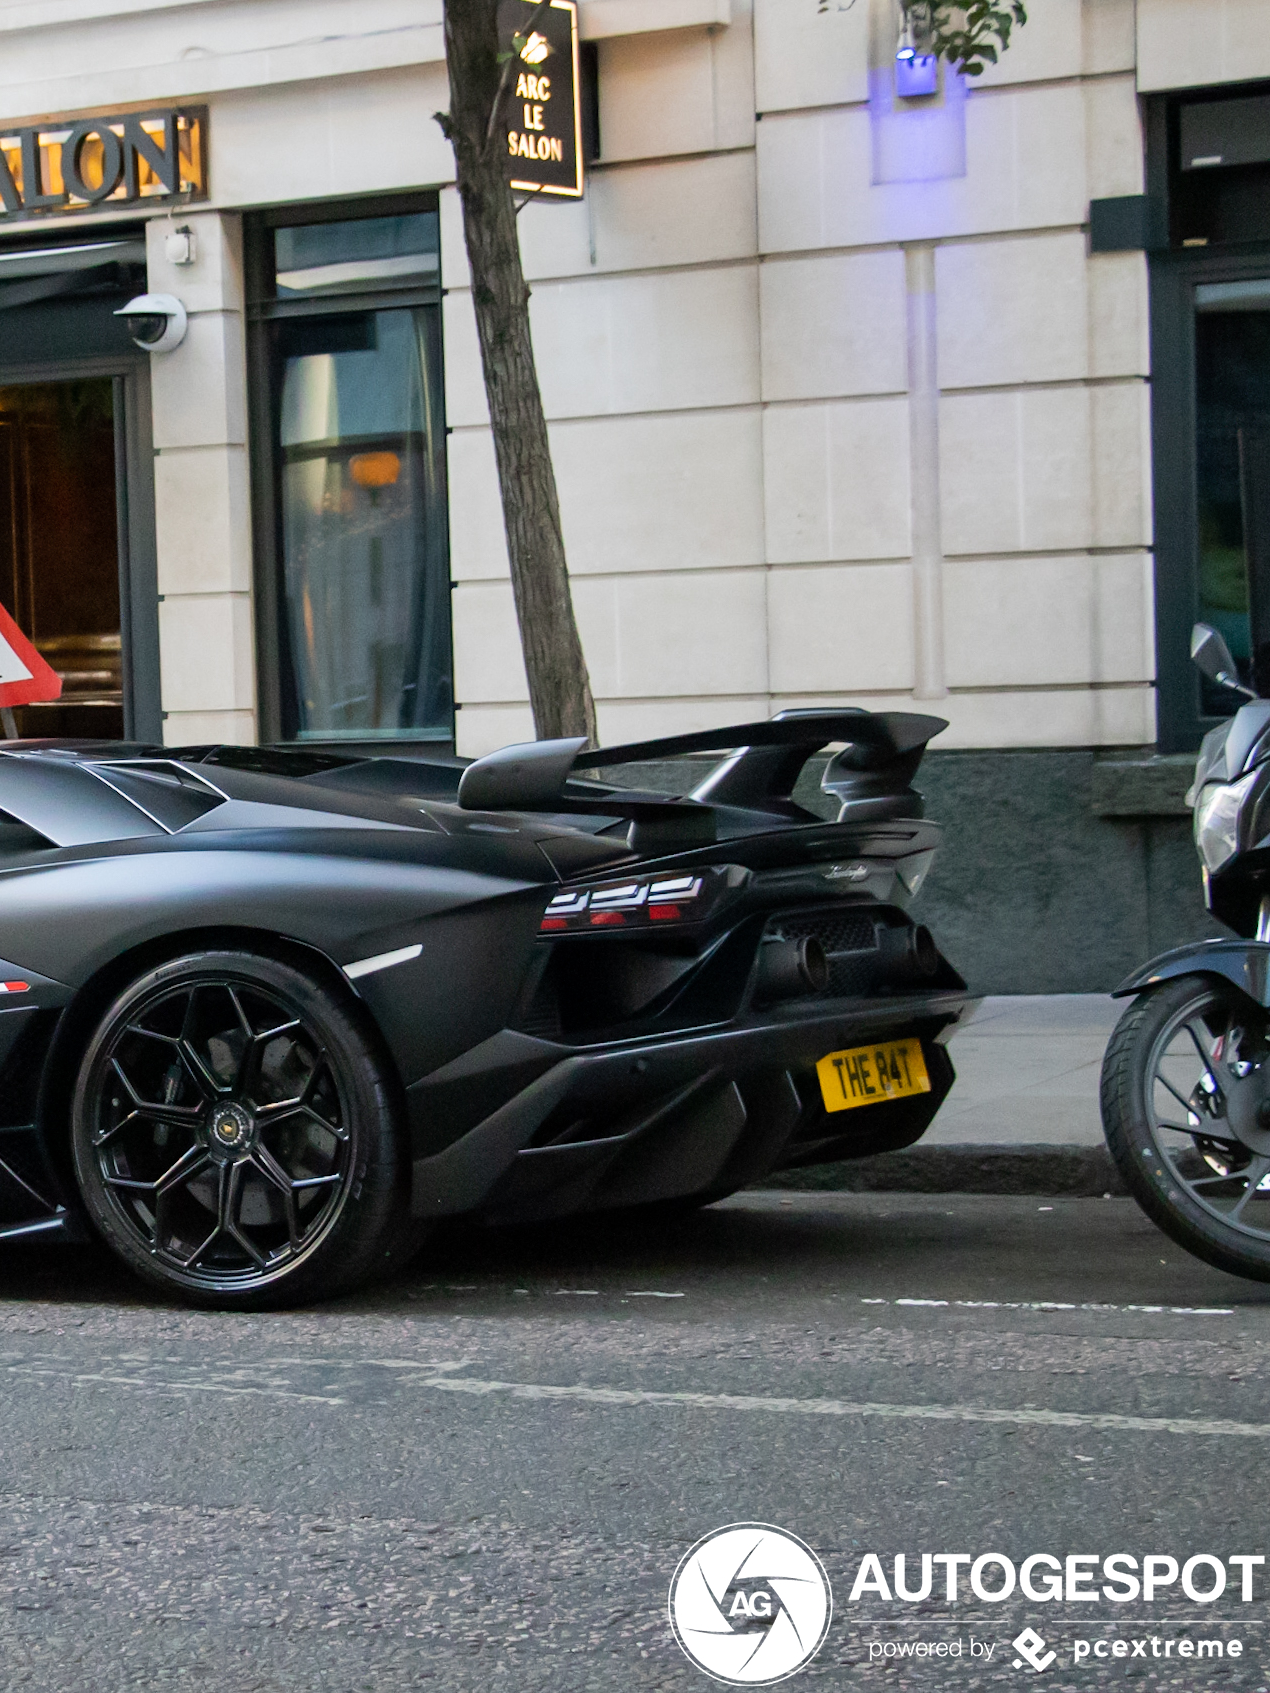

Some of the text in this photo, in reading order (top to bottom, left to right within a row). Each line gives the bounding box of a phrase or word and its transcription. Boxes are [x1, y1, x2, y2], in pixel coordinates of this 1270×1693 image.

[516, 73, 551, 101] ARC
[523, 104, 544, 131] LE
[508, 131, 563, 162] SALON
[832, 1054, 876, 1099] THE
